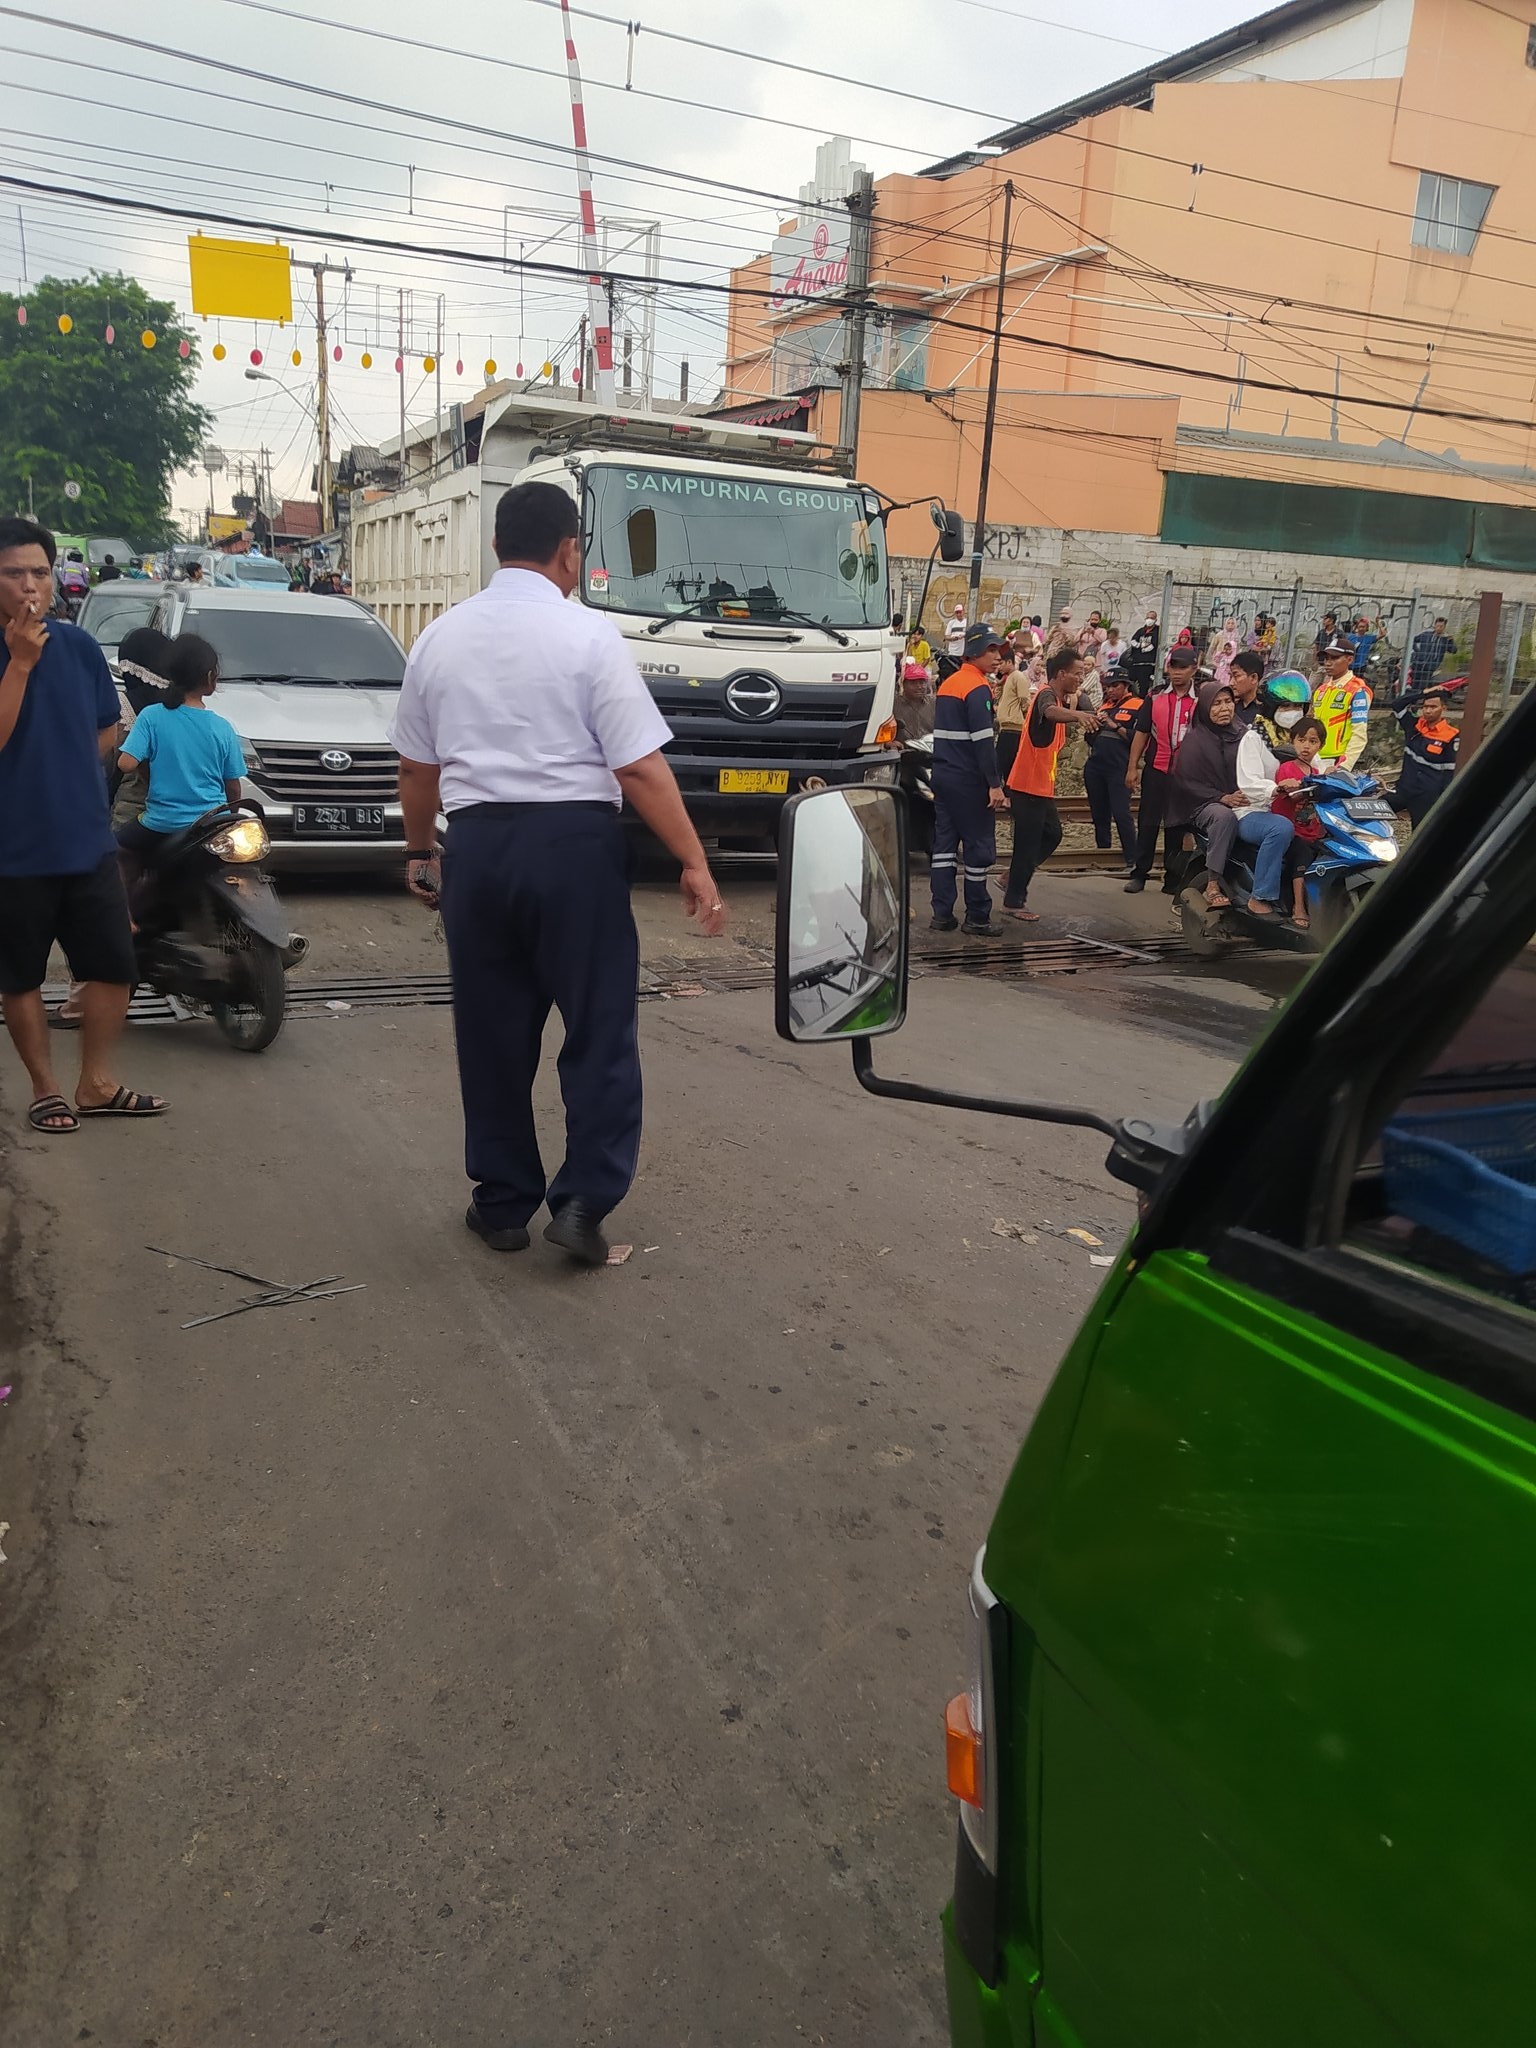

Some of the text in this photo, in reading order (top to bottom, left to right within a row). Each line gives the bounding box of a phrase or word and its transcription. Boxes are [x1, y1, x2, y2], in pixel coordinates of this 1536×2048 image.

[625, 473, 769, 504] SAMPURNA
[778, 490, 856, 513] GROUP
[831, 672, 869, 682] 500
[723, 772, 730, 785] B
[297, 808, 306, 823] B
[356, 809, 381, 824] BIS
